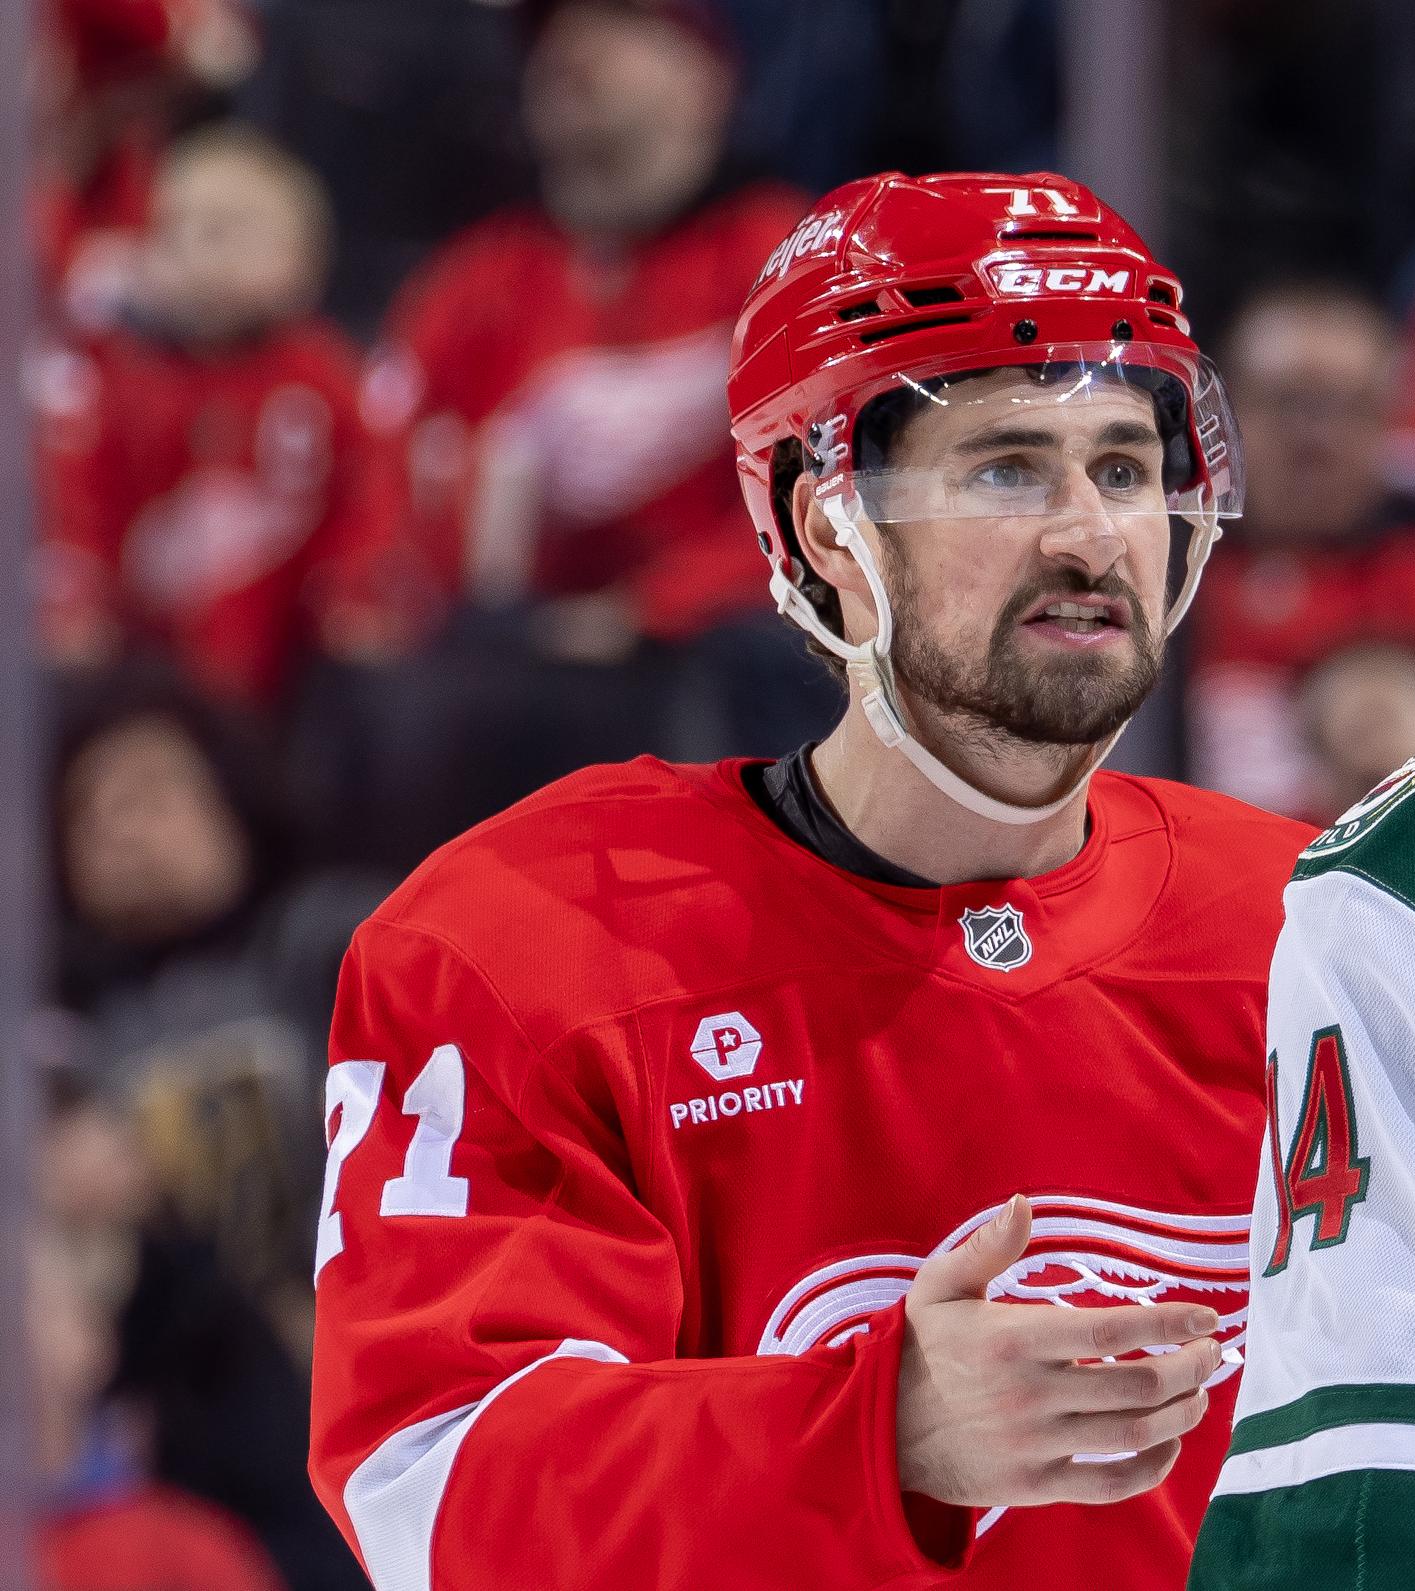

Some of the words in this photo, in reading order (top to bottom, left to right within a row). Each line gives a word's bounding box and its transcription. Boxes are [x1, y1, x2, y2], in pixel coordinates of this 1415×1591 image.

[977, 187, 1080, 216] 71
[998, 268, 1130, 294] CCM
[980, 922, 1014, 959] NHL
[670, 1079, 804, 1129] PRIORITY
[314, 1043, 469, 1291] 71
